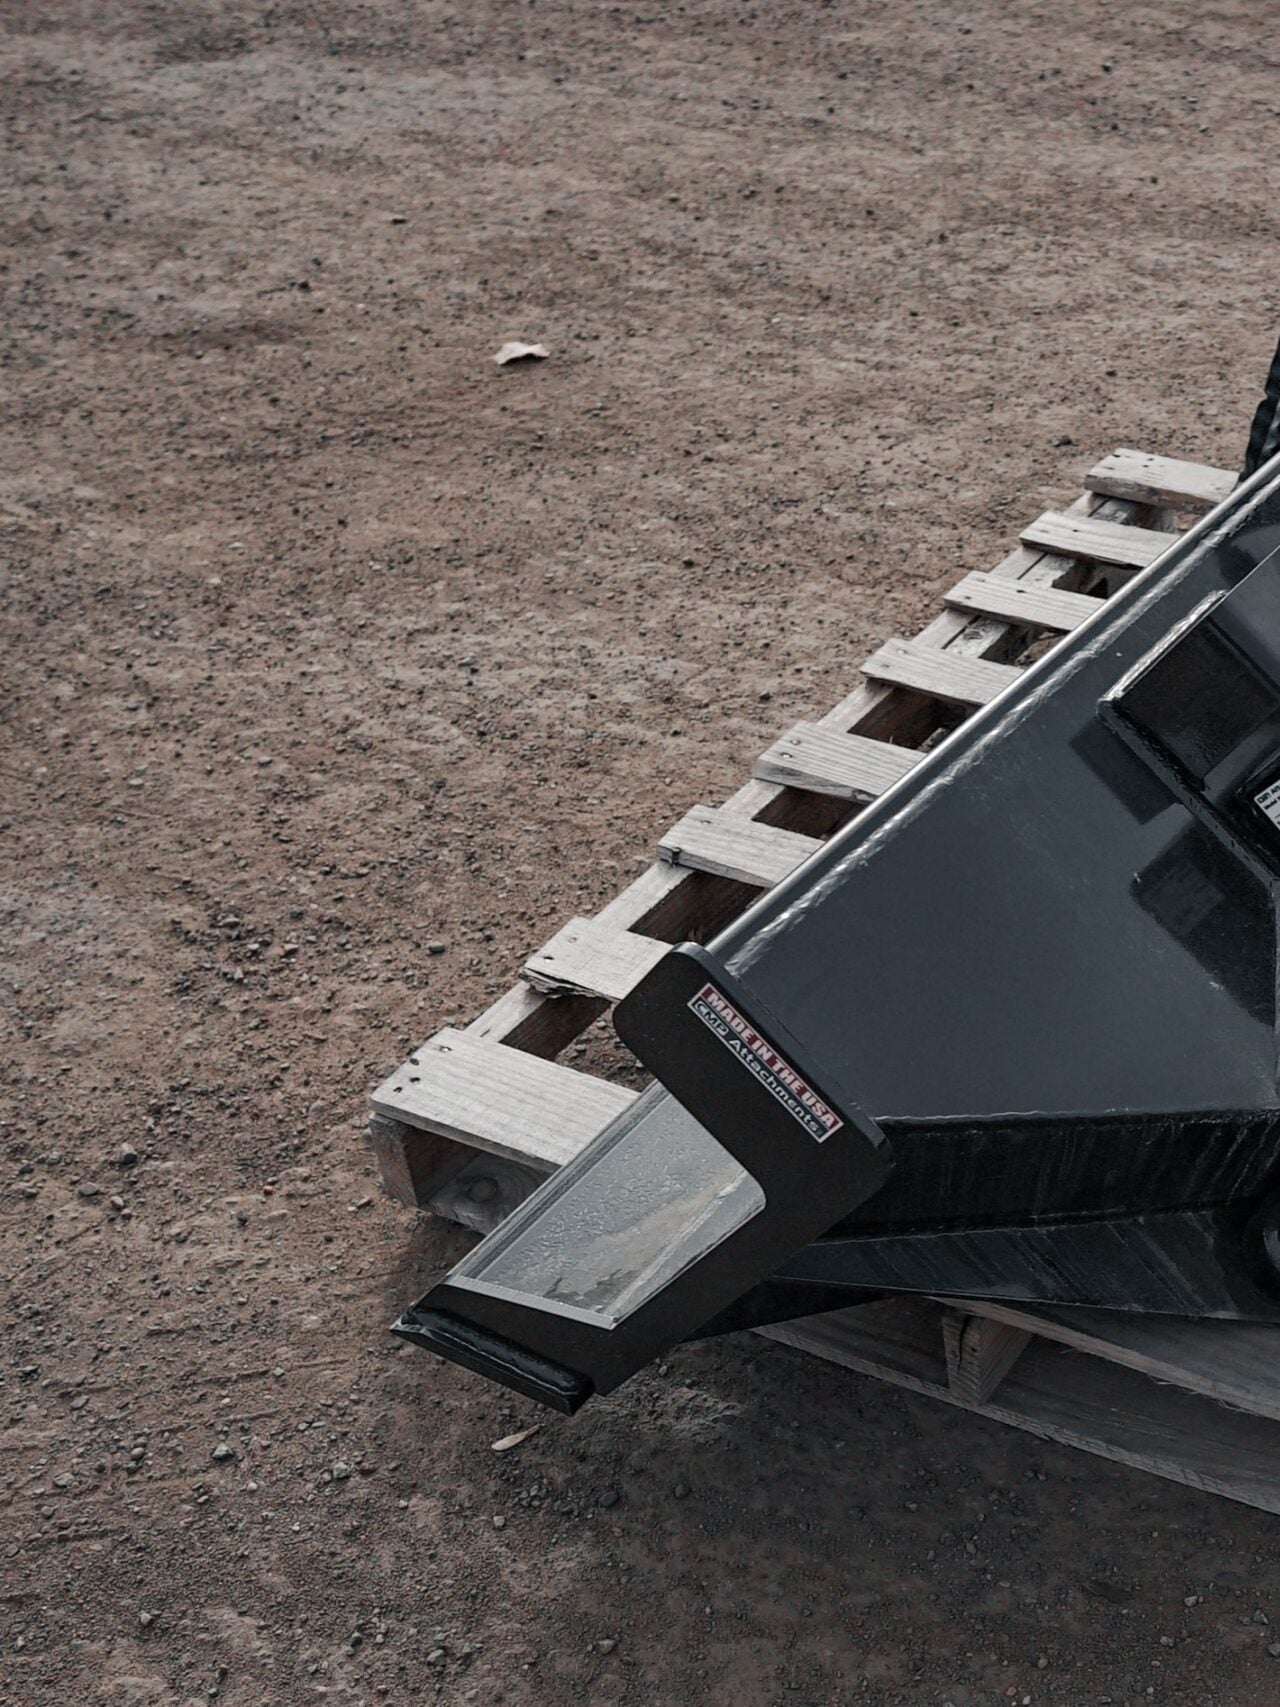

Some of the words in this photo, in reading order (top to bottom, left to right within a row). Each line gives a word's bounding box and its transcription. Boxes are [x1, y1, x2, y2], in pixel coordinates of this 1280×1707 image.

[694, 1000, 730, 1037] CMP
[728, 1039, 819, 1132] Attachments
[707, 992, 757, 1043] MADE
[751, 1040, 773, 1061] IN
[772, 1058, 804, 1095] THE
[801, 1091, 836, 1128] USA
